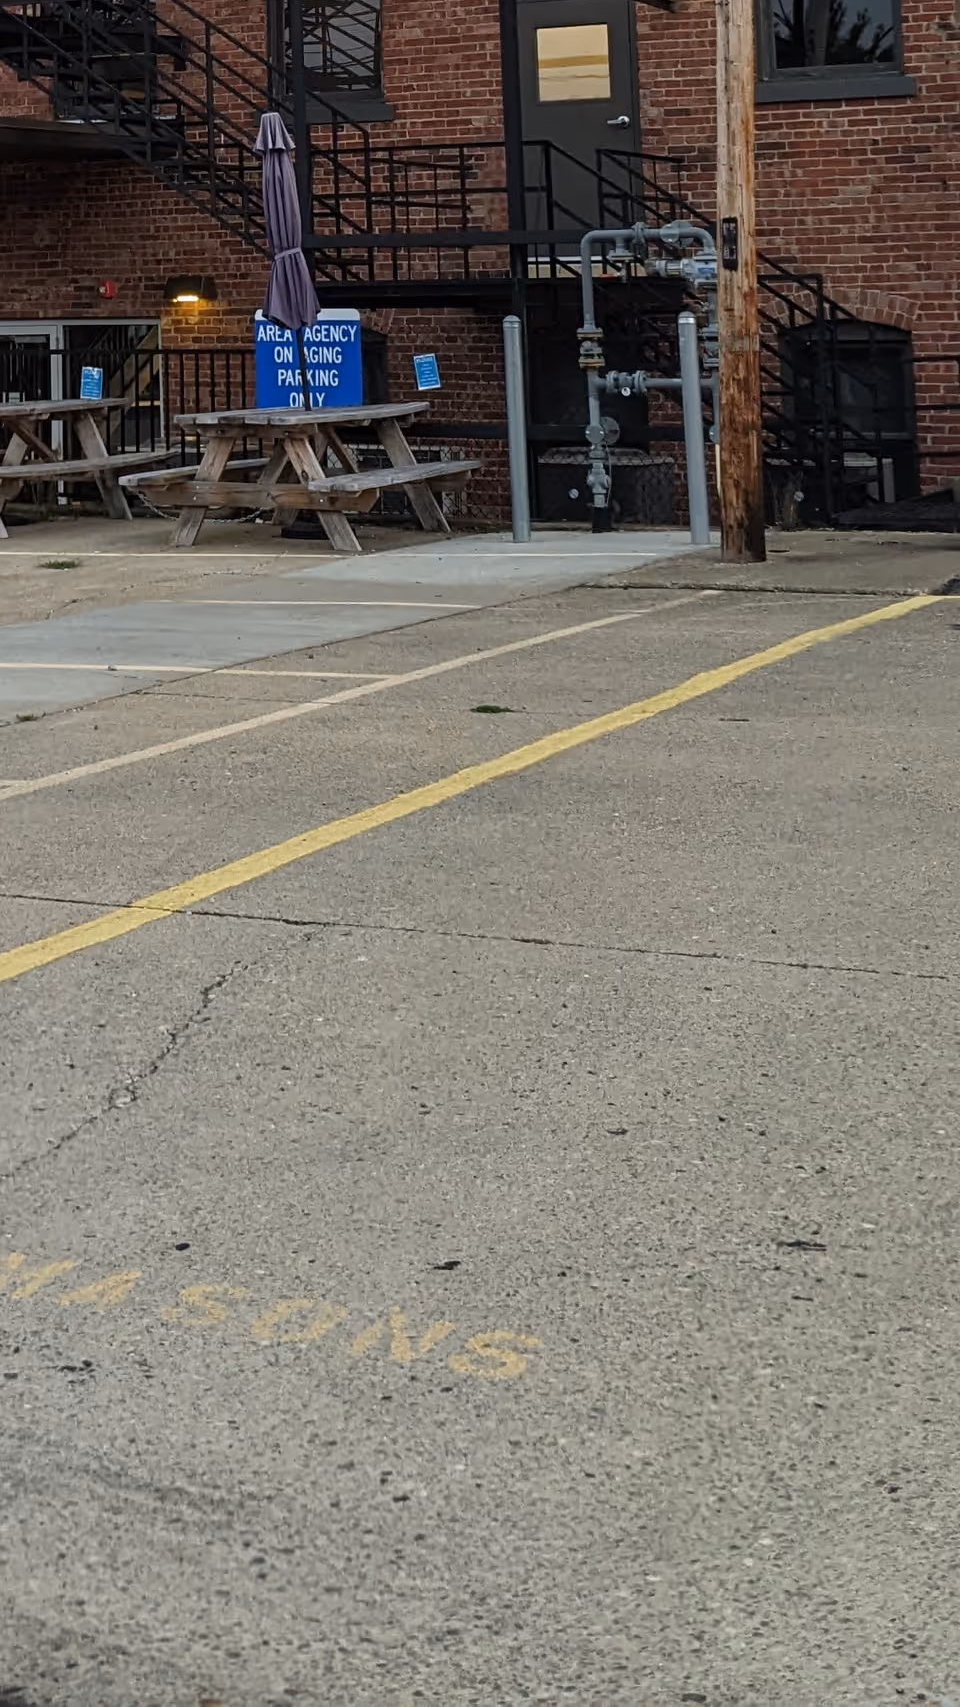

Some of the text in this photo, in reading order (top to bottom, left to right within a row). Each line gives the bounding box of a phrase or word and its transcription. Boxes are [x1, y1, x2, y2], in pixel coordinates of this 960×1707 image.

[257, 325, 357, 342] AREA AGENCY
[274, 346, 342, 364] ON AGING
[277, 368, 339, 387] PARKING
